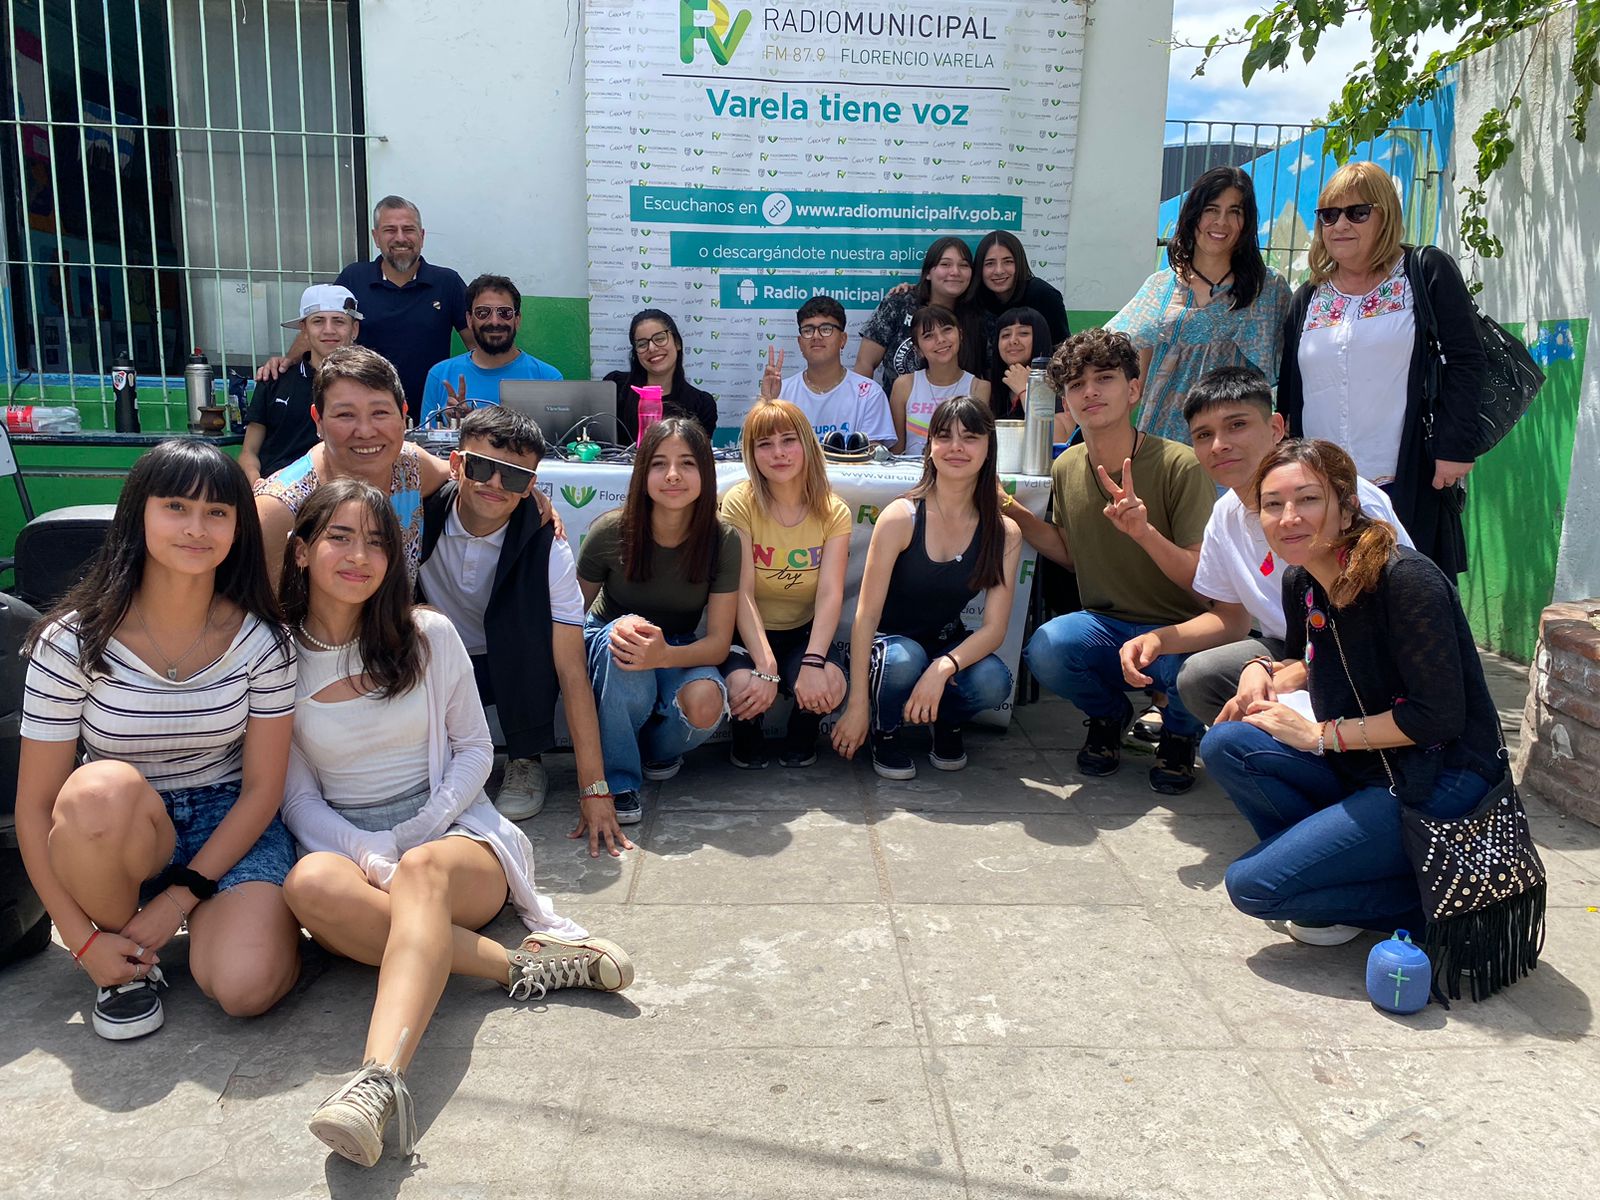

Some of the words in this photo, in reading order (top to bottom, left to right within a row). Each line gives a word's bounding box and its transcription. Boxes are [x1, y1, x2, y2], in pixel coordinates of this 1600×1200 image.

[764, 8, 997, 40] RADIOMUNICIPAL
[765, 45, 788, 62] FM
[793, 47, 826, 62] 87.9
[841, 48, 929, 67] FLORENCIO
[933, 51, 995, 69] VARELA
[706, 88, 808, 120] Varela
[819, 93, 901, 123] tiene
[912, 103, 969, 125] voz
[644, 196, 734, 214] Escuchanos
[739, 201, 757, 215] en
[796, 204, 1017, 223] www.radiomunicipalfv.gob.ar
[698, 247, 709, 258] o
[713, 245, 826, 262] descargándote
[830, 247, 885, 261] nuestra
[763, 285, 808, 300] Radio
[812, 287, 885, 303] Municipal
[812, 424, 837, 435] URO
[766, 560, 804, 590] try
